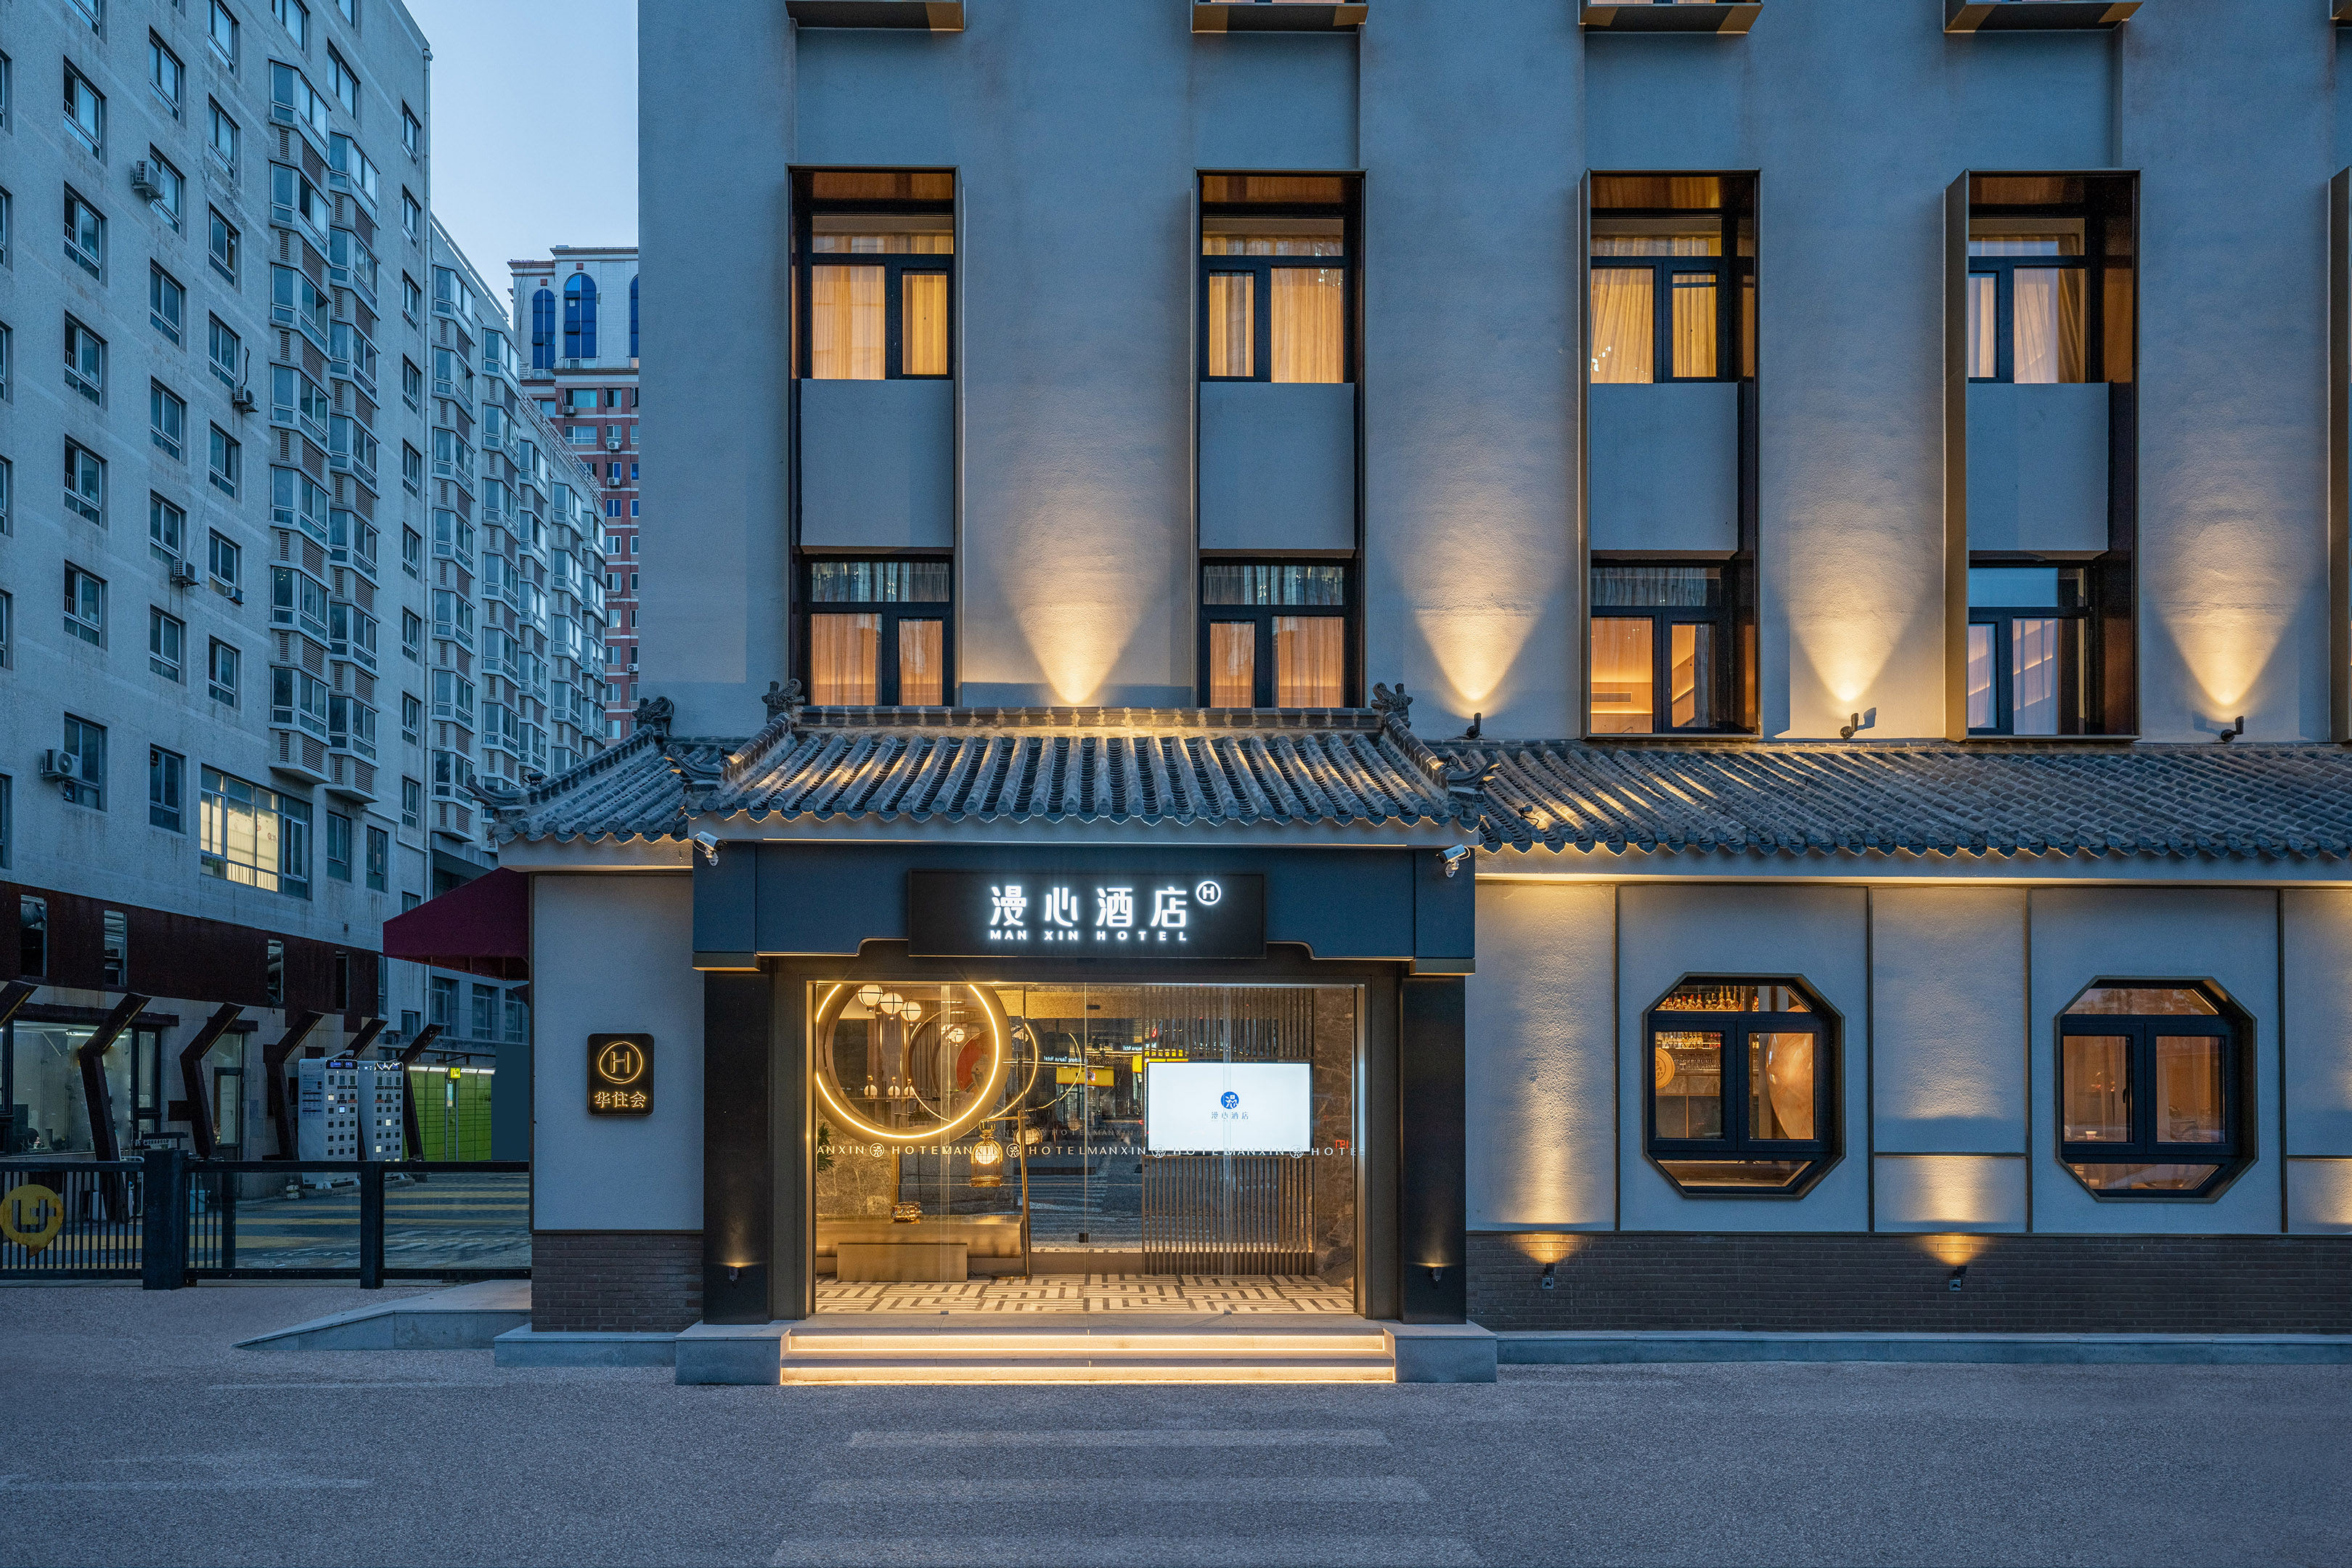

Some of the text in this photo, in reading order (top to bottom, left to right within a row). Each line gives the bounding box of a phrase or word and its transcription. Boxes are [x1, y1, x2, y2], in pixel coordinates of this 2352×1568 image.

[990, 885, 1187, 928] 漫心酒店
[989, 930, 1187, 942] MAN XIN HOTEL
[595, 1091, 646, 1108] 华住会
[1029, 1146, 1086, 1155] HOTEL
[1087, 1146, 1146, 1155] MANXIN
